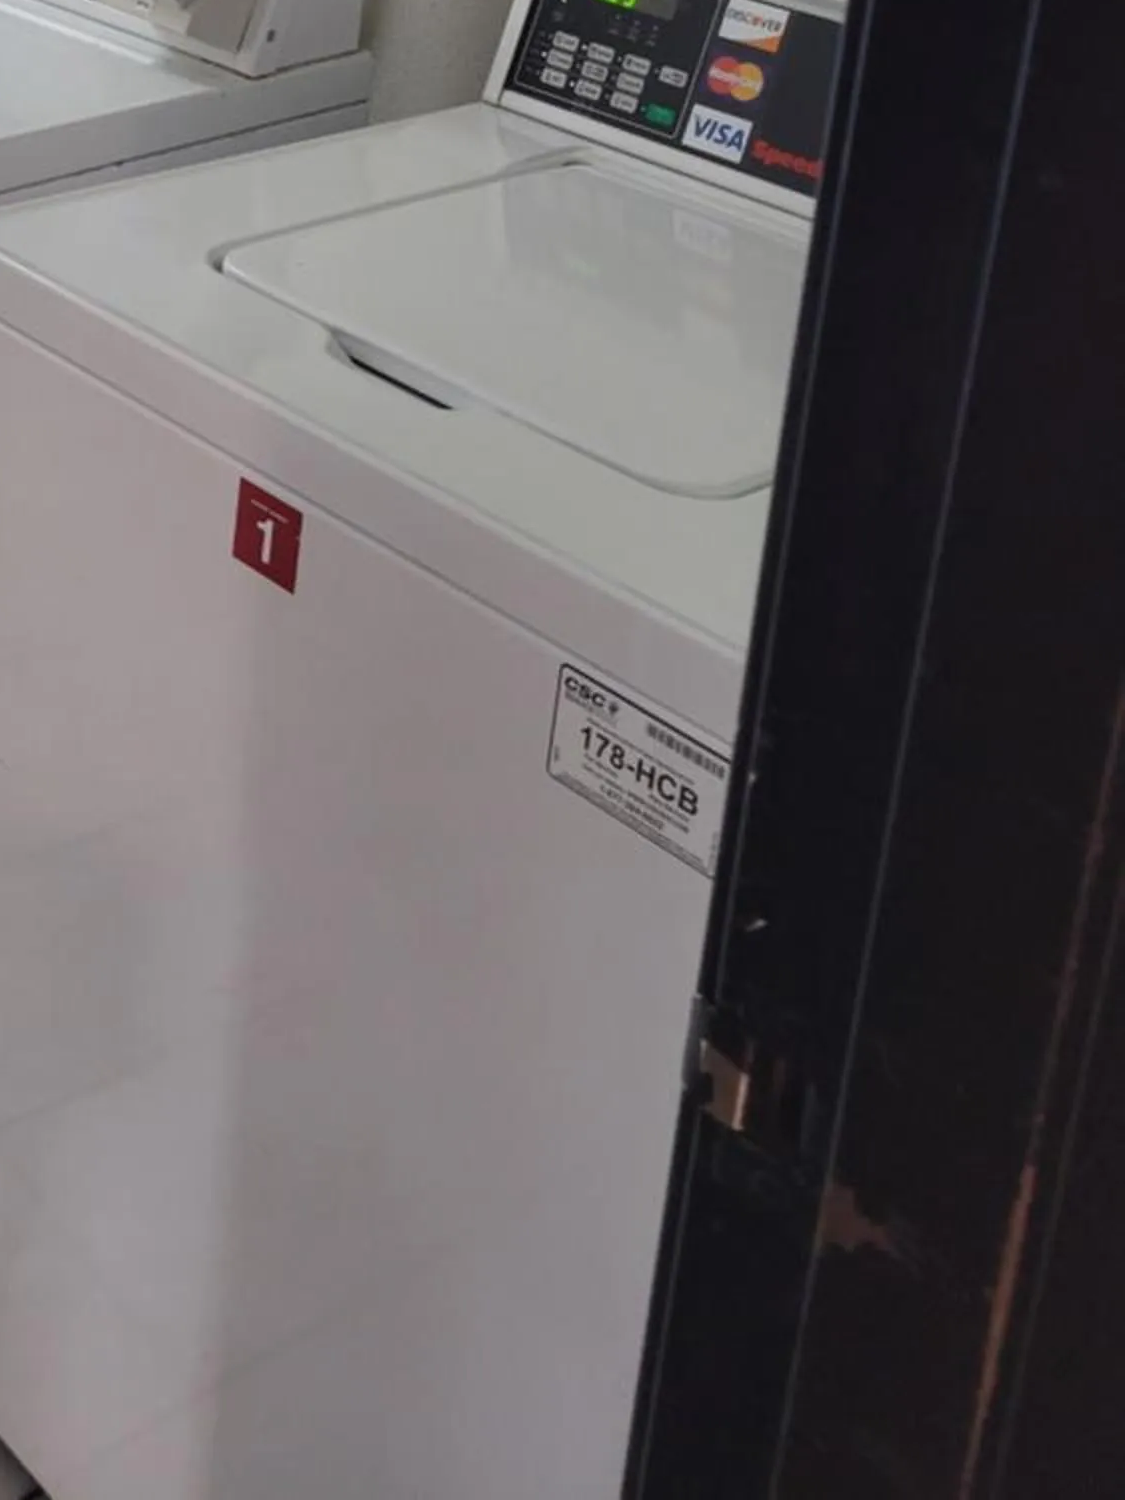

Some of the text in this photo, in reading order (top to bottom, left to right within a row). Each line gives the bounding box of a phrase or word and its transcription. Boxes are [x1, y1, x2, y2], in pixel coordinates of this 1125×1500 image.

[693, 116, 746, 152] VISA
[256, 518, 275, 565] 1
[563, 676, 607, 708] CSC
[580, 726, 699, 817] 178-HCB
